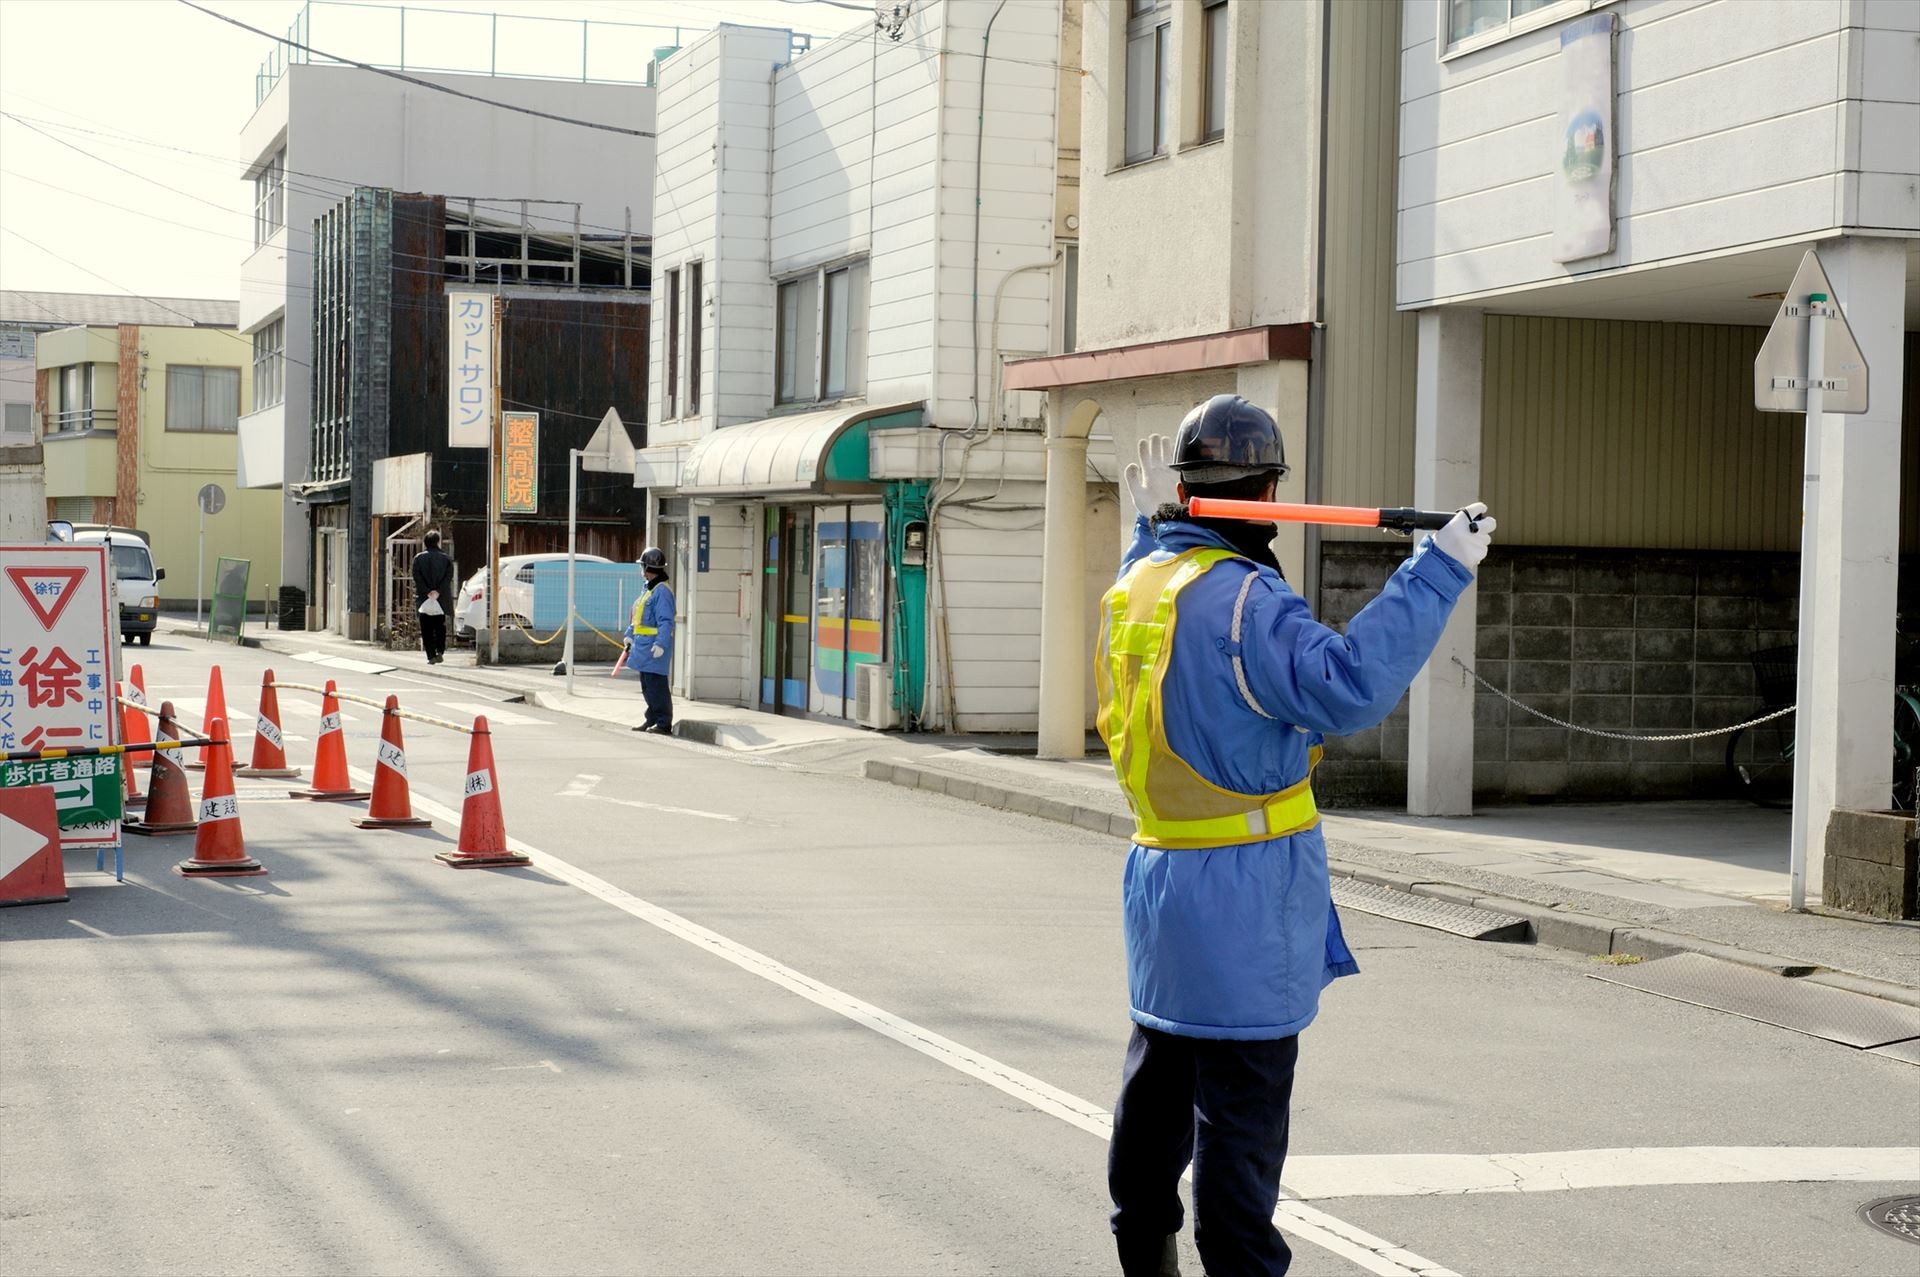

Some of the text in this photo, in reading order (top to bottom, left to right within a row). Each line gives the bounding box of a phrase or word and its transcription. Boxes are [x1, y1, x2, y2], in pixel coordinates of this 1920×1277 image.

[458, 299, 484, 425] カットサロン
[507, 418, 534, 505] 整骨院
[34, 582, 62, 595] 徐行
[6, 756, 116, 786] 歩行者通路
